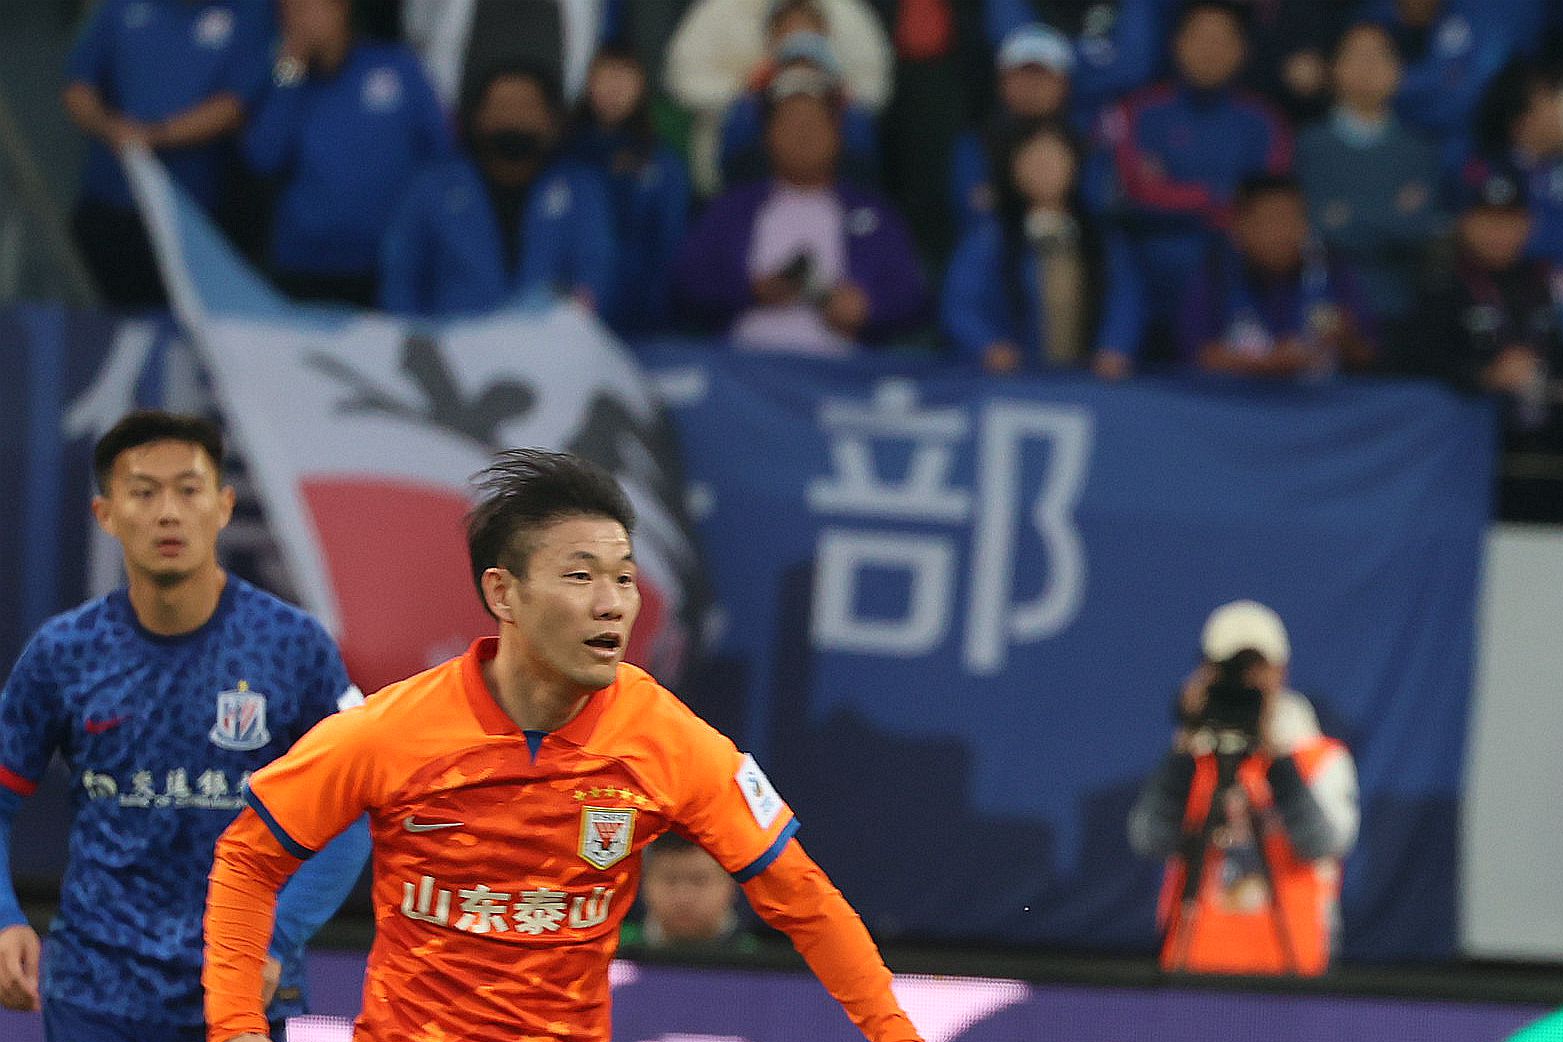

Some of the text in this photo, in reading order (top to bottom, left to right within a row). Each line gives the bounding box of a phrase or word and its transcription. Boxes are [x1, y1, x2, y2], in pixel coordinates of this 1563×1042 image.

[807, 376, 1095, 677] 部
[401, 875, 615, 934] 山东泰山
